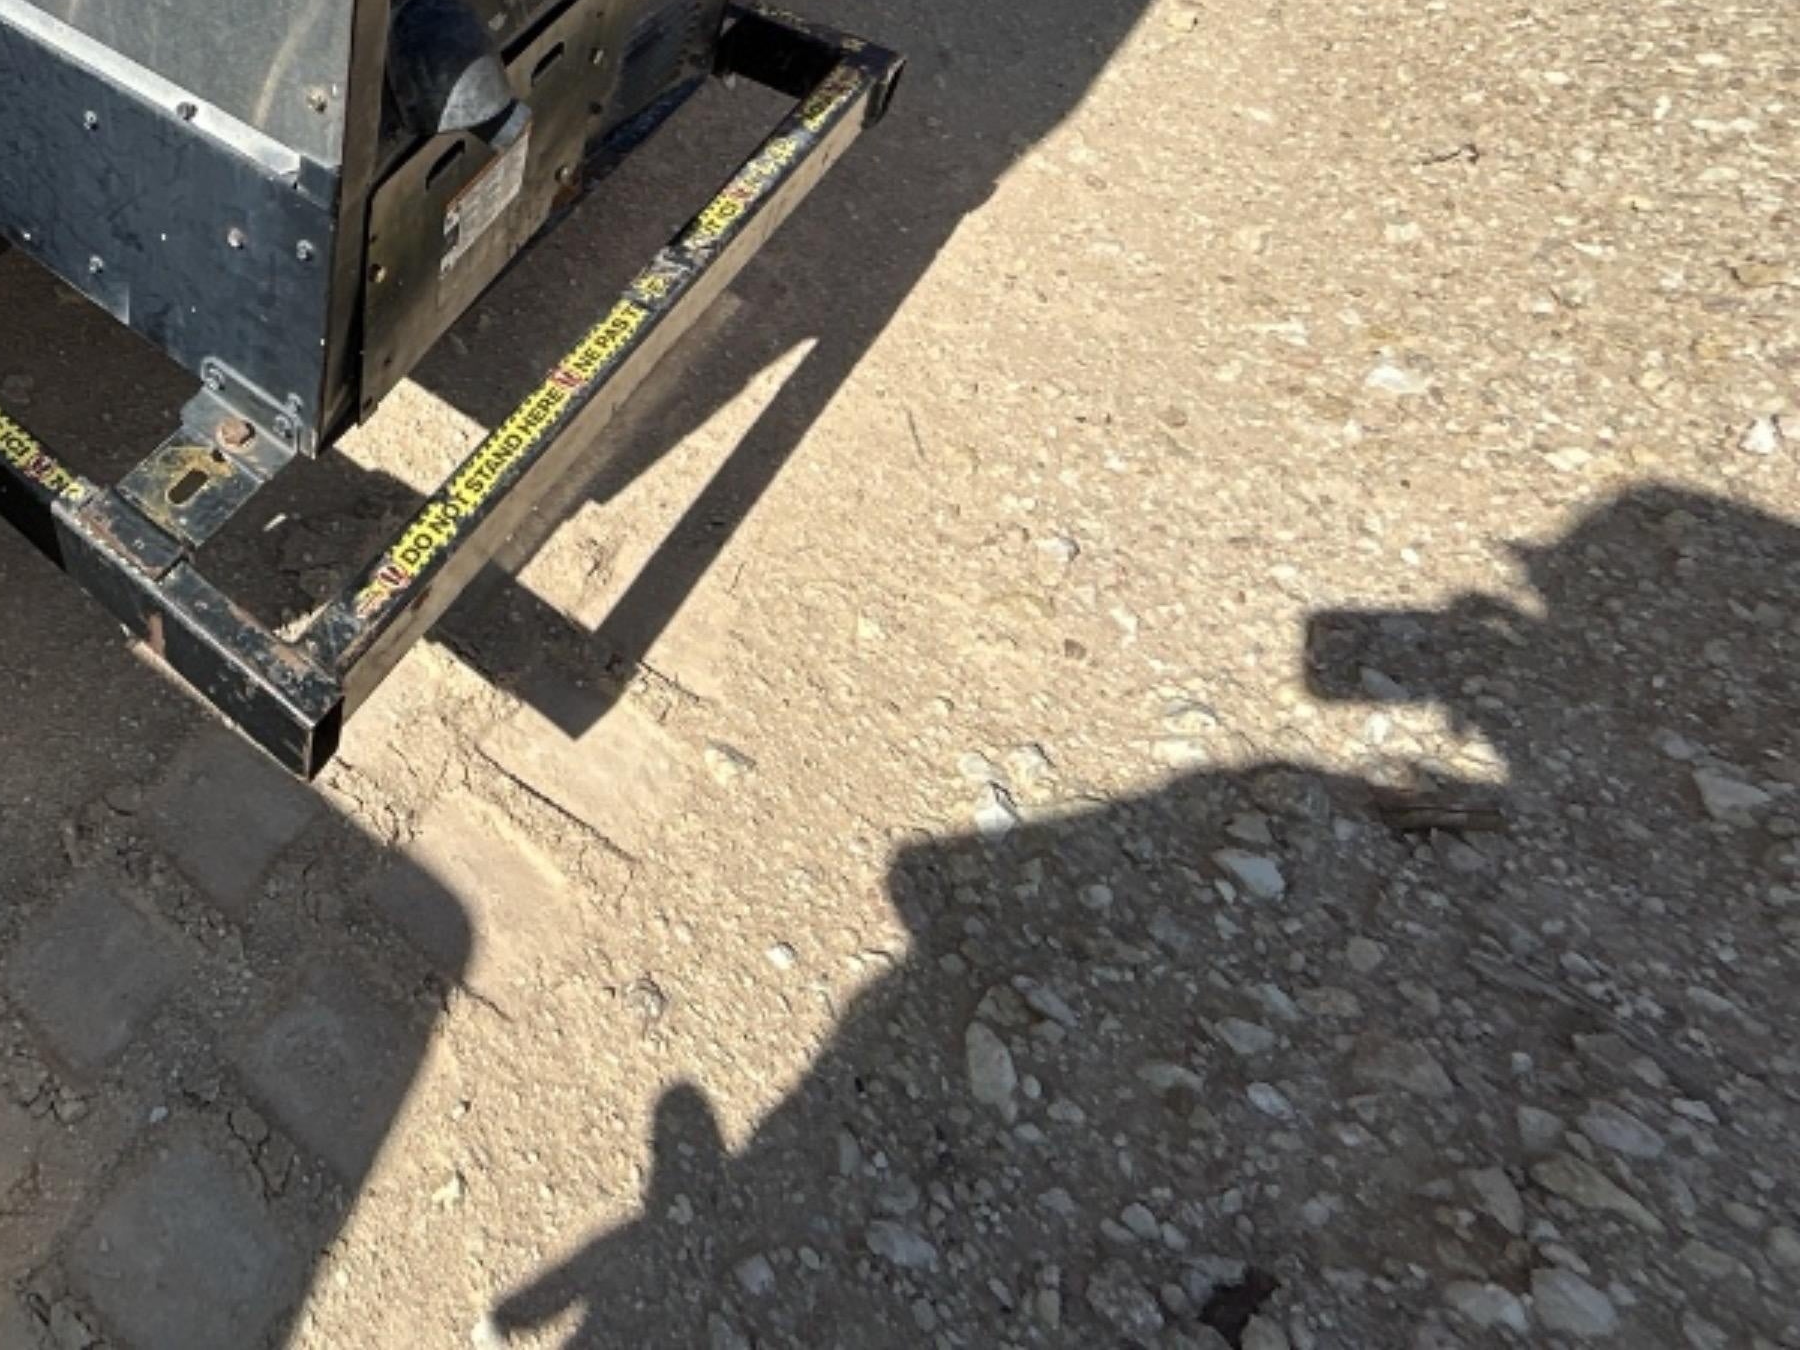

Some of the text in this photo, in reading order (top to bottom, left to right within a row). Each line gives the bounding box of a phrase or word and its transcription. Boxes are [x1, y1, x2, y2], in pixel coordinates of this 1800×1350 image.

[0, 430, 32, 457] ICI
[400, 531, 434, 566] DO
[428, 489, 470, 535] NOT
[464, 432, 524, 494] STAND
[519, 385, 565, 436] HERE
[572, 346, 601, 371] NE
